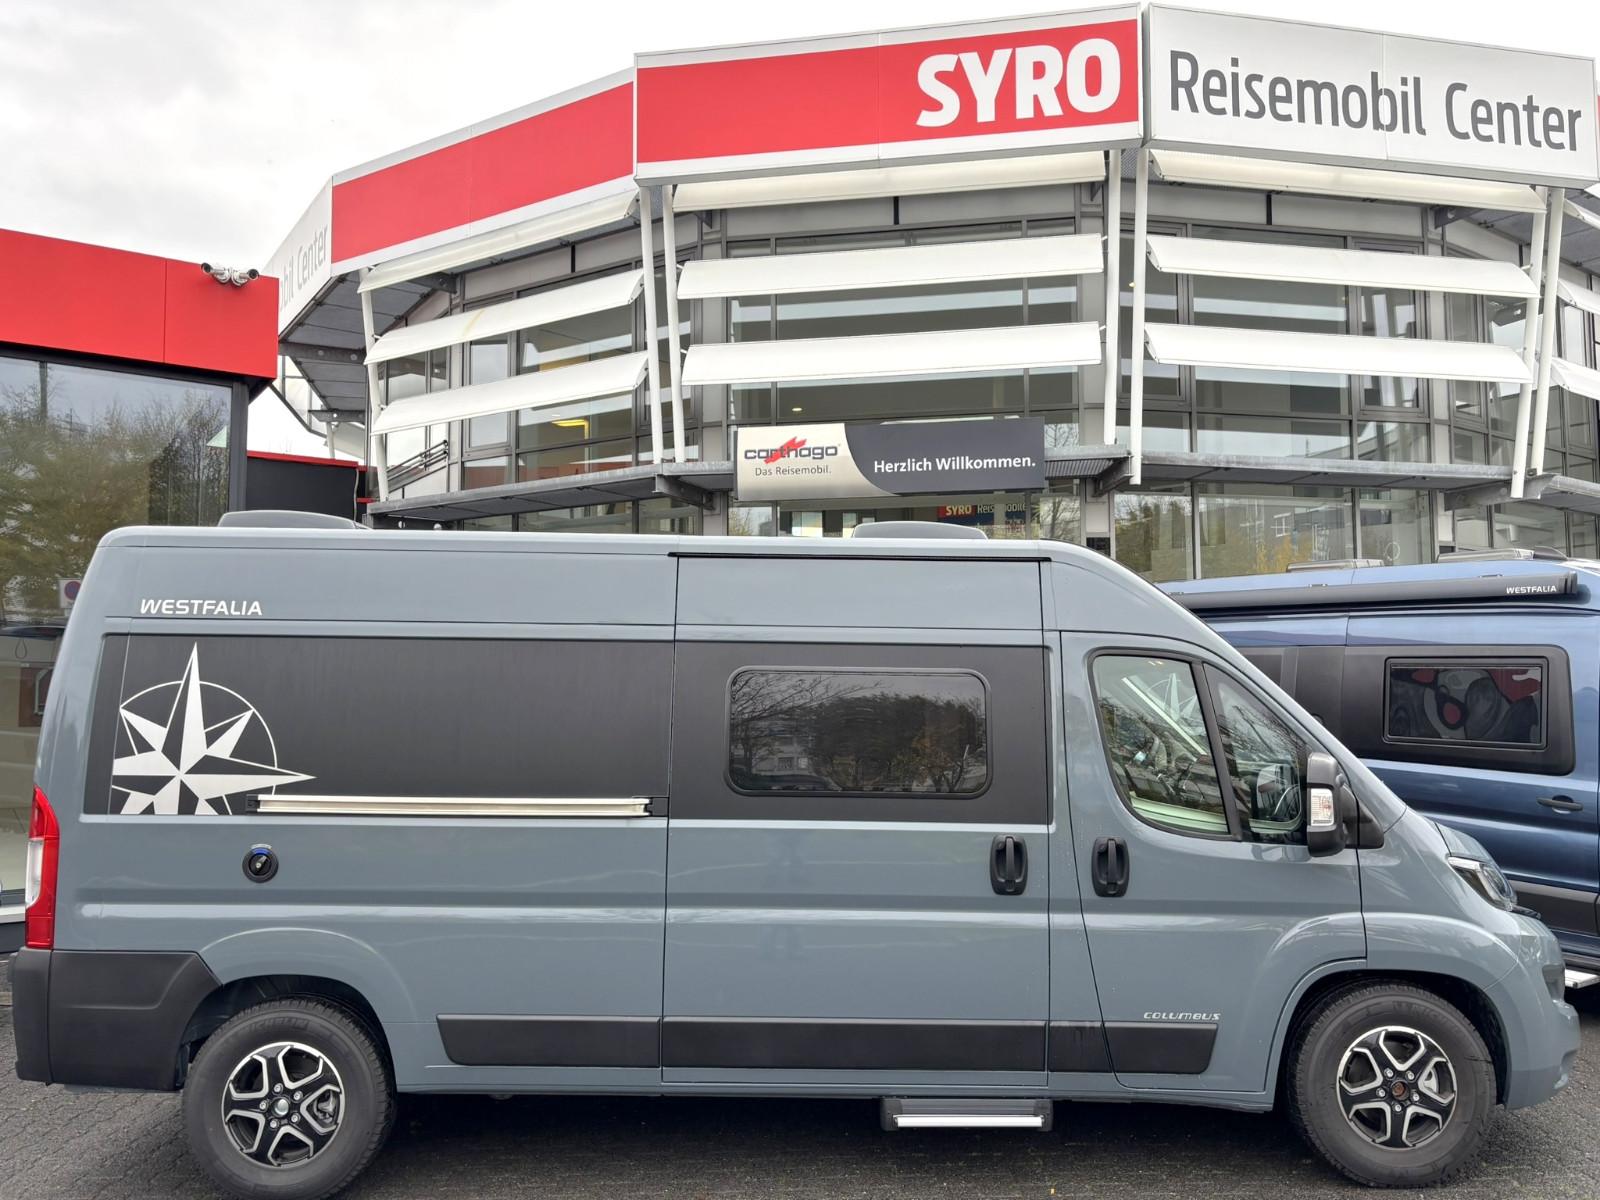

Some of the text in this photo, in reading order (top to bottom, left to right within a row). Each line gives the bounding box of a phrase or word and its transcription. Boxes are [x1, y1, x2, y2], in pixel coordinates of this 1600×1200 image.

[916, 38, 1121, 126] SYRO
[1170, 50, 1582, 151] Reisemobil Center
[297, 224, 328, 290] Center
[755, 464, 832, 476] Das Reisemobil.
[873, 455, 1036, 473] Herzlich Willkommen.
[945, 504, 972, 516] SYRO
[1506, 585, 1557, 594] WESTFALIA
[140, 599, 263, 616] WESTFALIA
